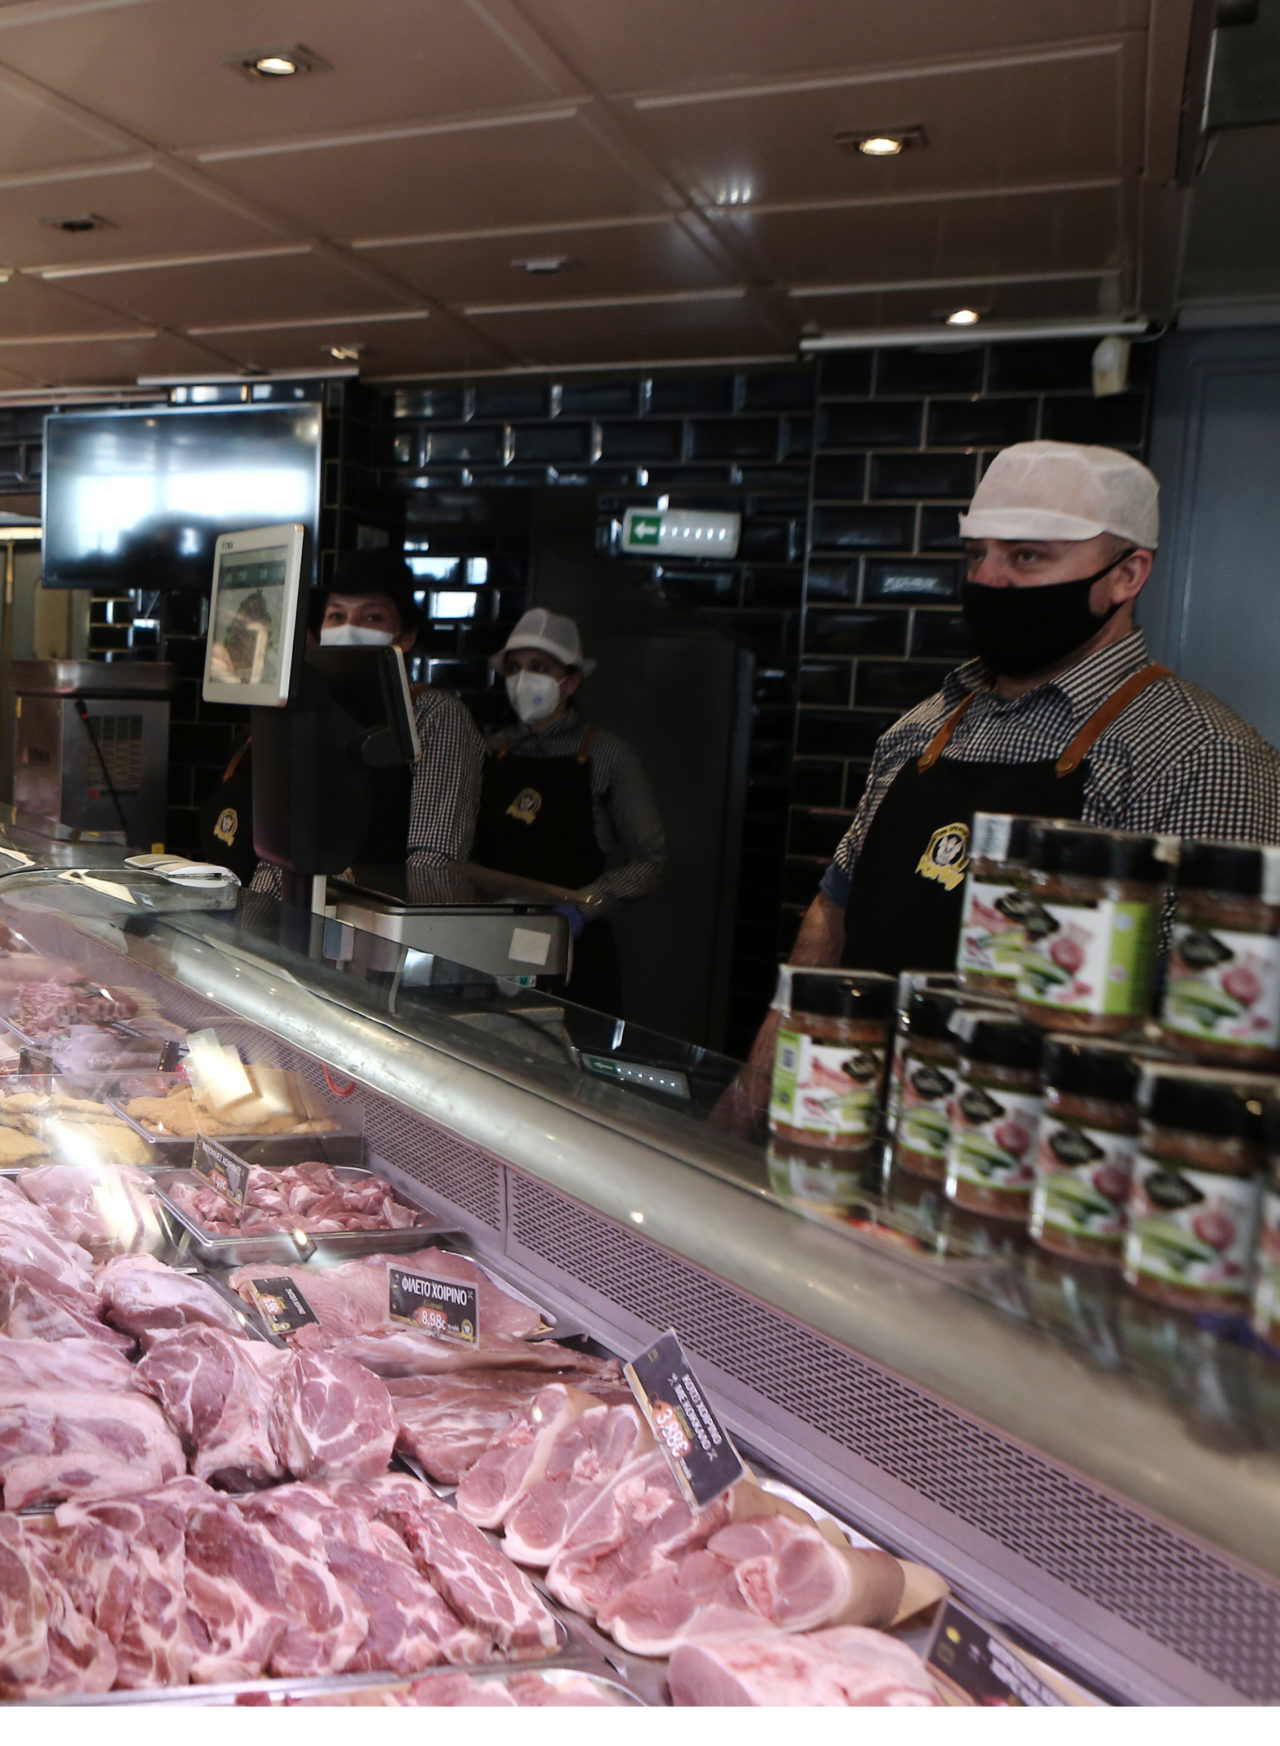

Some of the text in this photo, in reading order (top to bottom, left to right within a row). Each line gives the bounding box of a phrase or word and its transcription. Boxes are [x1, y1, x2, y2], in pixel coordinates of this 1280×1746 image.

[401, 1275, 431, 1297] ΦΙΛΕΤΟ
[432, 1283, 467, 1306] ΧΟΙΡΙΝΟ
[696, 1402, 723, 1446] ΧΟΙΡΙΝΟ
